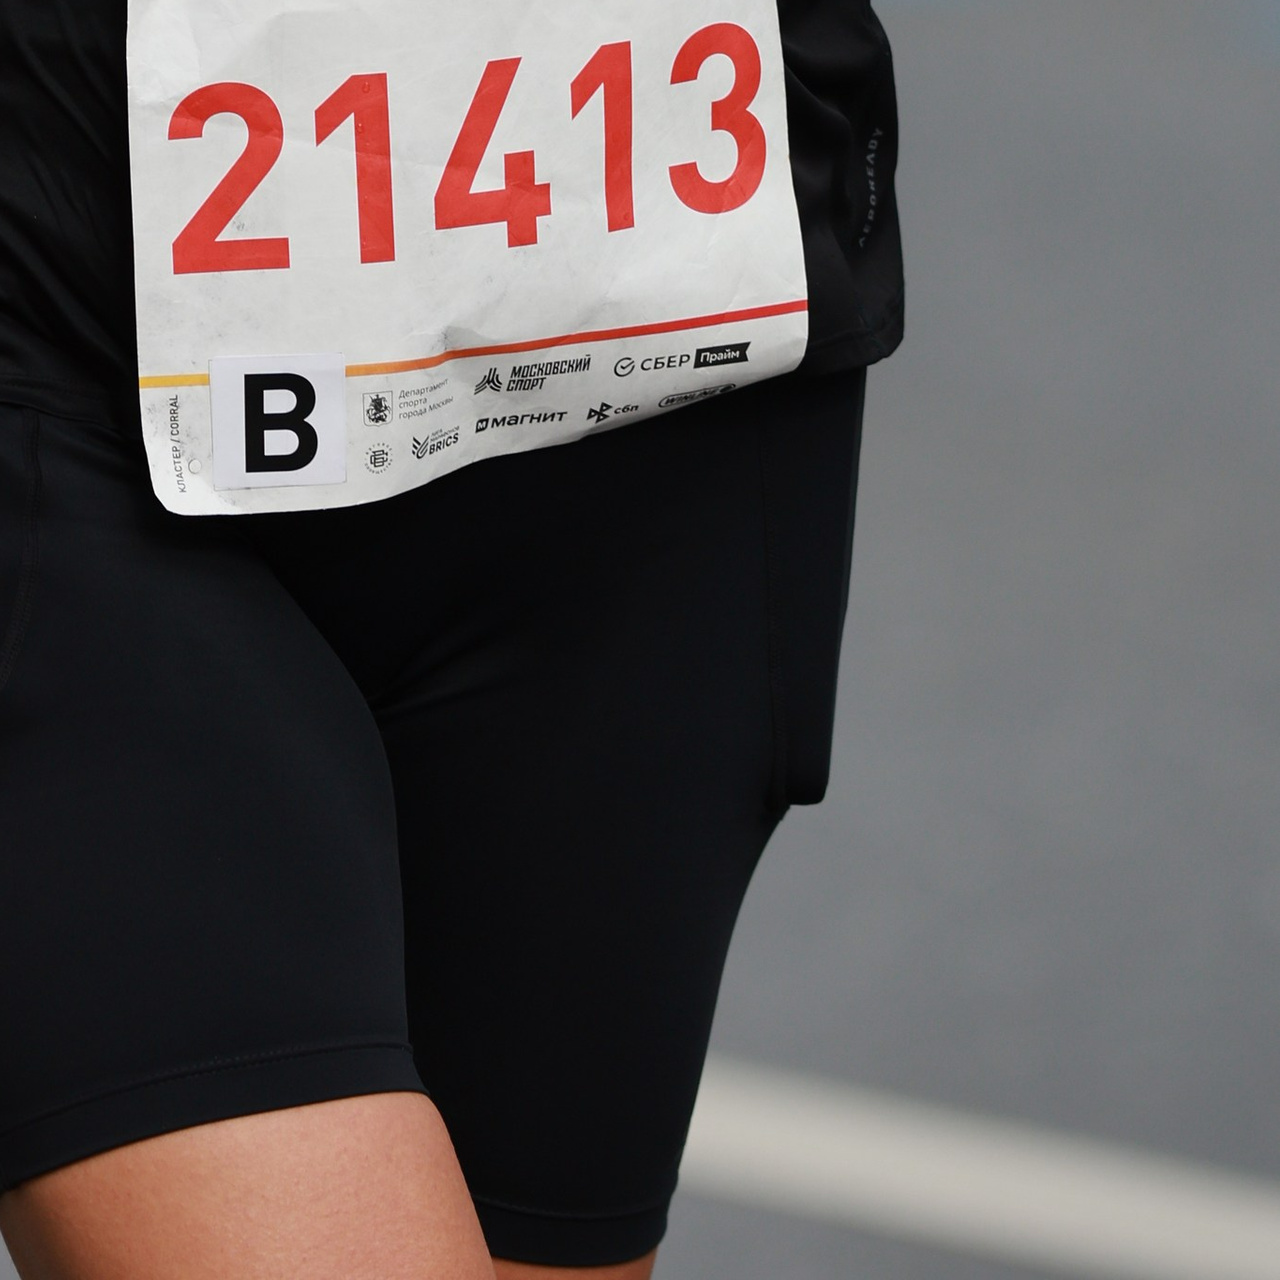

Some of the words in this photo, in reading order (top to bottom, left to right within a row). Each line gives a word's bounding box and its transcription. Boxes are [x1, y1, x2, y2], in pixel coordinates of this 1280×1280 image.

[167, 23, 767, 275] 21413
[510, 354, 591, 379] МОСКОВСКИЙ
[640, 354, 691, 371] СБЕР
[700, 348, 740, 364] Прайм
[506, 377, 547, 392] СПОРТ
[169, 394, 178, 436] CORRAL
[399, 397, 428, 409] спорта
[399, 408, 427, 420] города
[244, 373, 318, 473] B
[429, 432, 459, 455] BRICS
[171, 445, 187, 493] КЛАСТЕР
